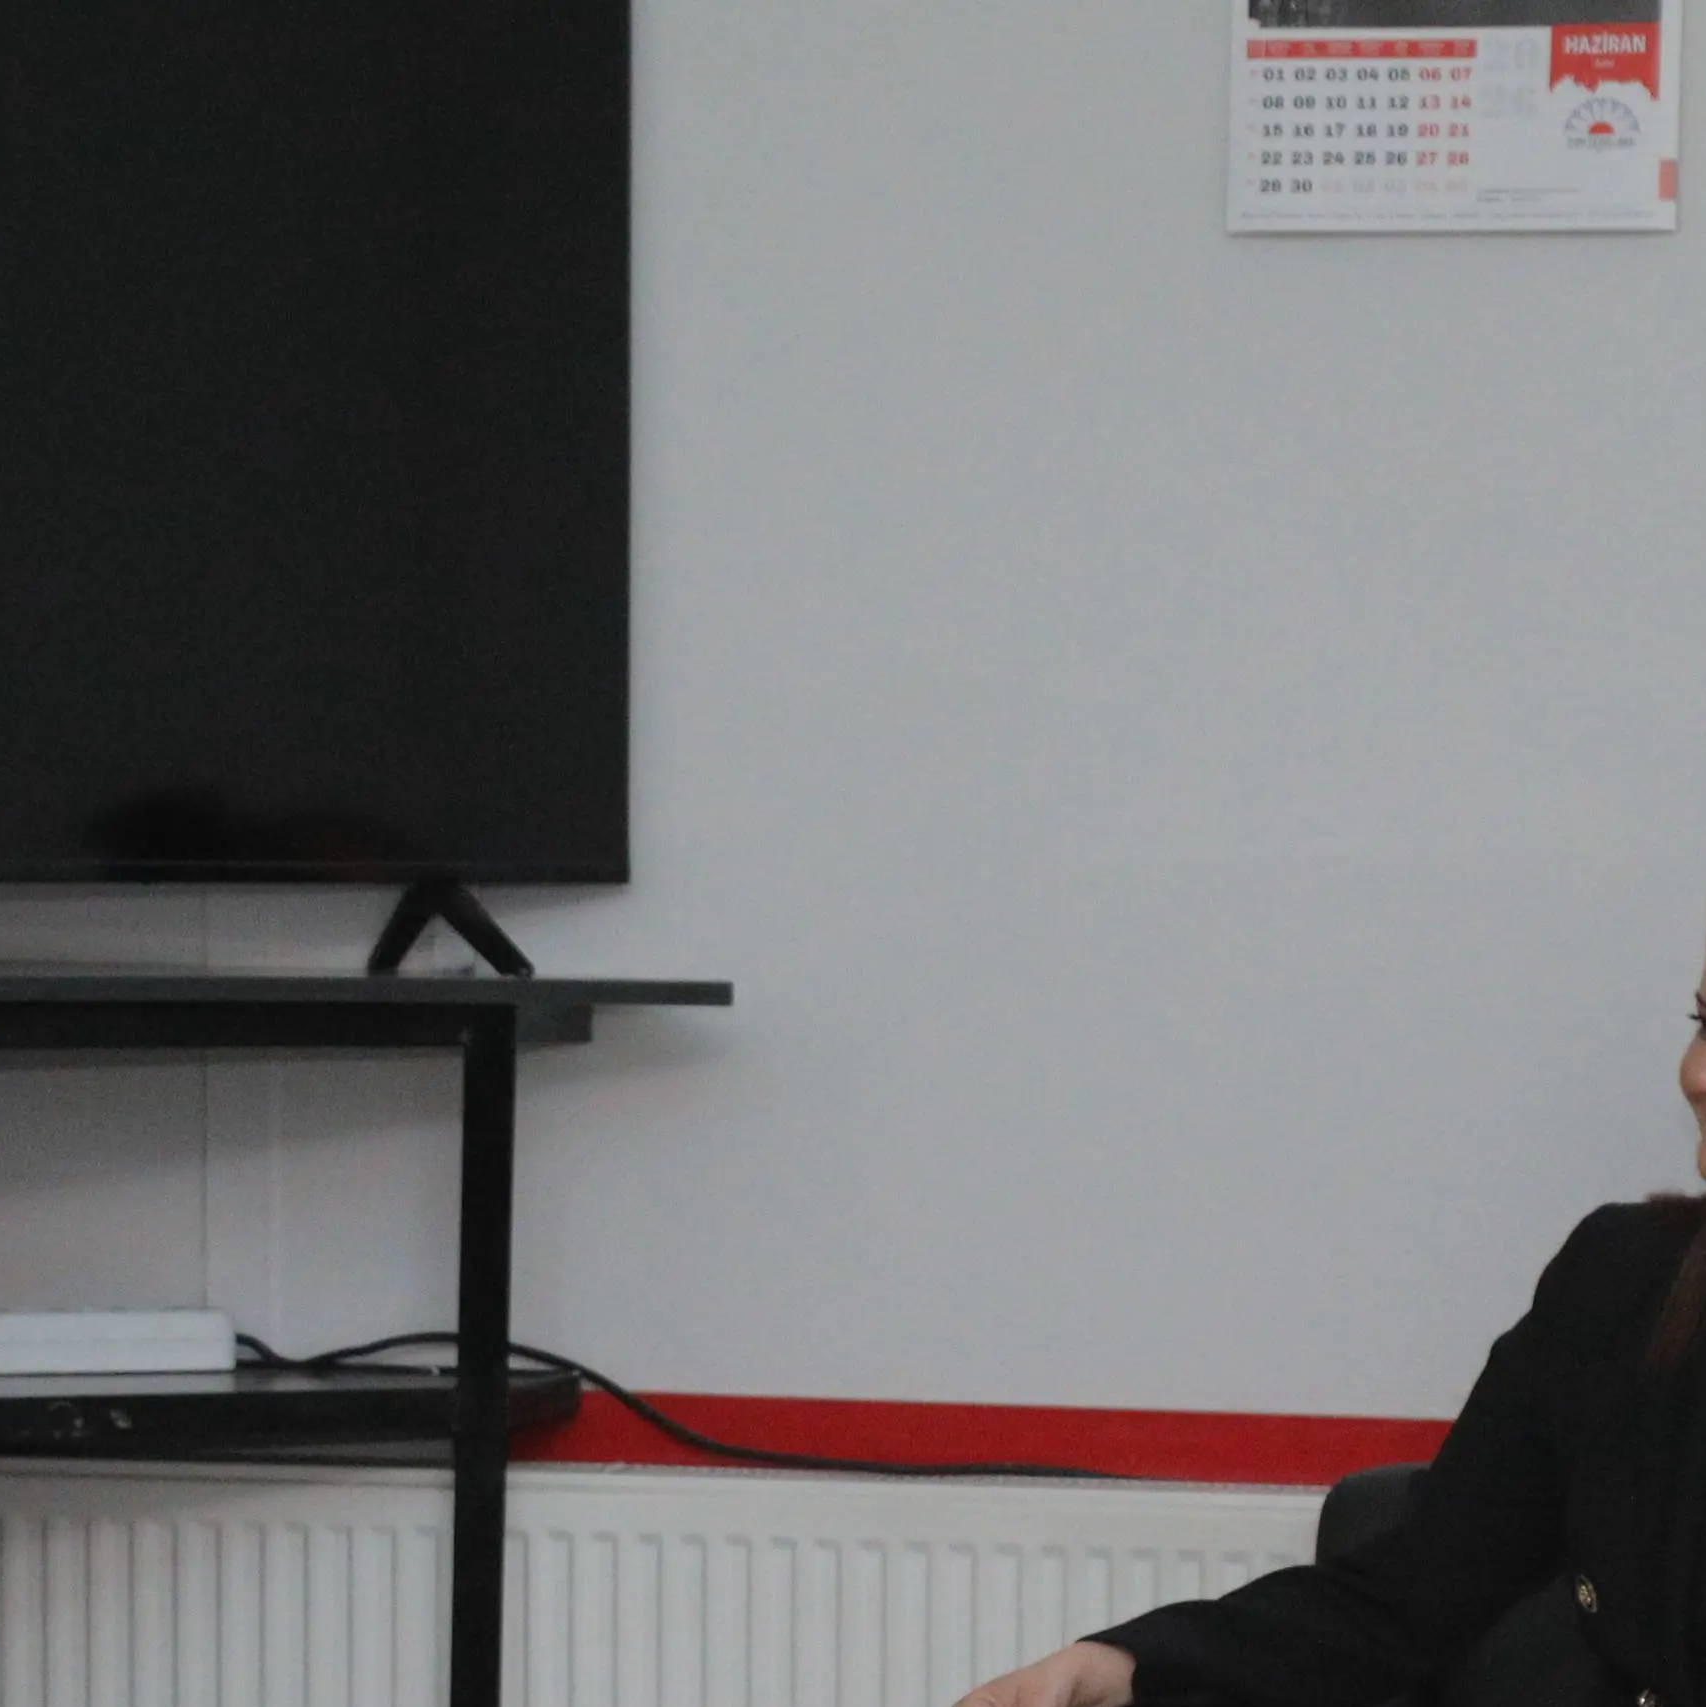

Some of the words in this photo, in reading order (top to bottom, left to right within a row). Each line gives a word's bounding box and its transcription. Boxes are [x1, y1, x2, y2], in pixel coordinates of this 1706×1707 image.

[1563, 31, 1647, 55] HAZİRAN
[1263, 68, 1284, 82] 01
[1294, 68, 1316, 81] 02
[1325, 68, 1347, 82] 03
[1357, 68, 1379, 81] 04
[1419, 68, 1441, 81] 06
[1449, 67, 1472, 82] 07
[1262, 96, 1284, 109] 08
[1293, 96, 1315, 109] 09
[1326, 96, 1346, 109] 10
[1357, 97, 1376, 109] 11
[1388, 96, 1409, 109] 12
[1419, 95, 1441, 109] 13
[1263, 124, 1283, 137] 15
[1294, 124, 1314, 137] 16
[1325, 122, 1345, 137] 17
[1357, 124, 1377, 137] 18
[1387, 124, 1408, 137] 19
[1417, 124, 1440, 137] 20
[1448, 123, 1469, 138] 21
[1261, 151, 1282, 165] 22
[1292, 151, 1313, 165] 23
[1323, 151, 1344, 165] 24
[1354, 151, 1376, 165] 25
[1386, 151, 1407, 166] 26
[1417, 151, 1437, 166] 27
[1447, 151, 1469, 165] 28
[1291, 179, 1312, 192] 30
